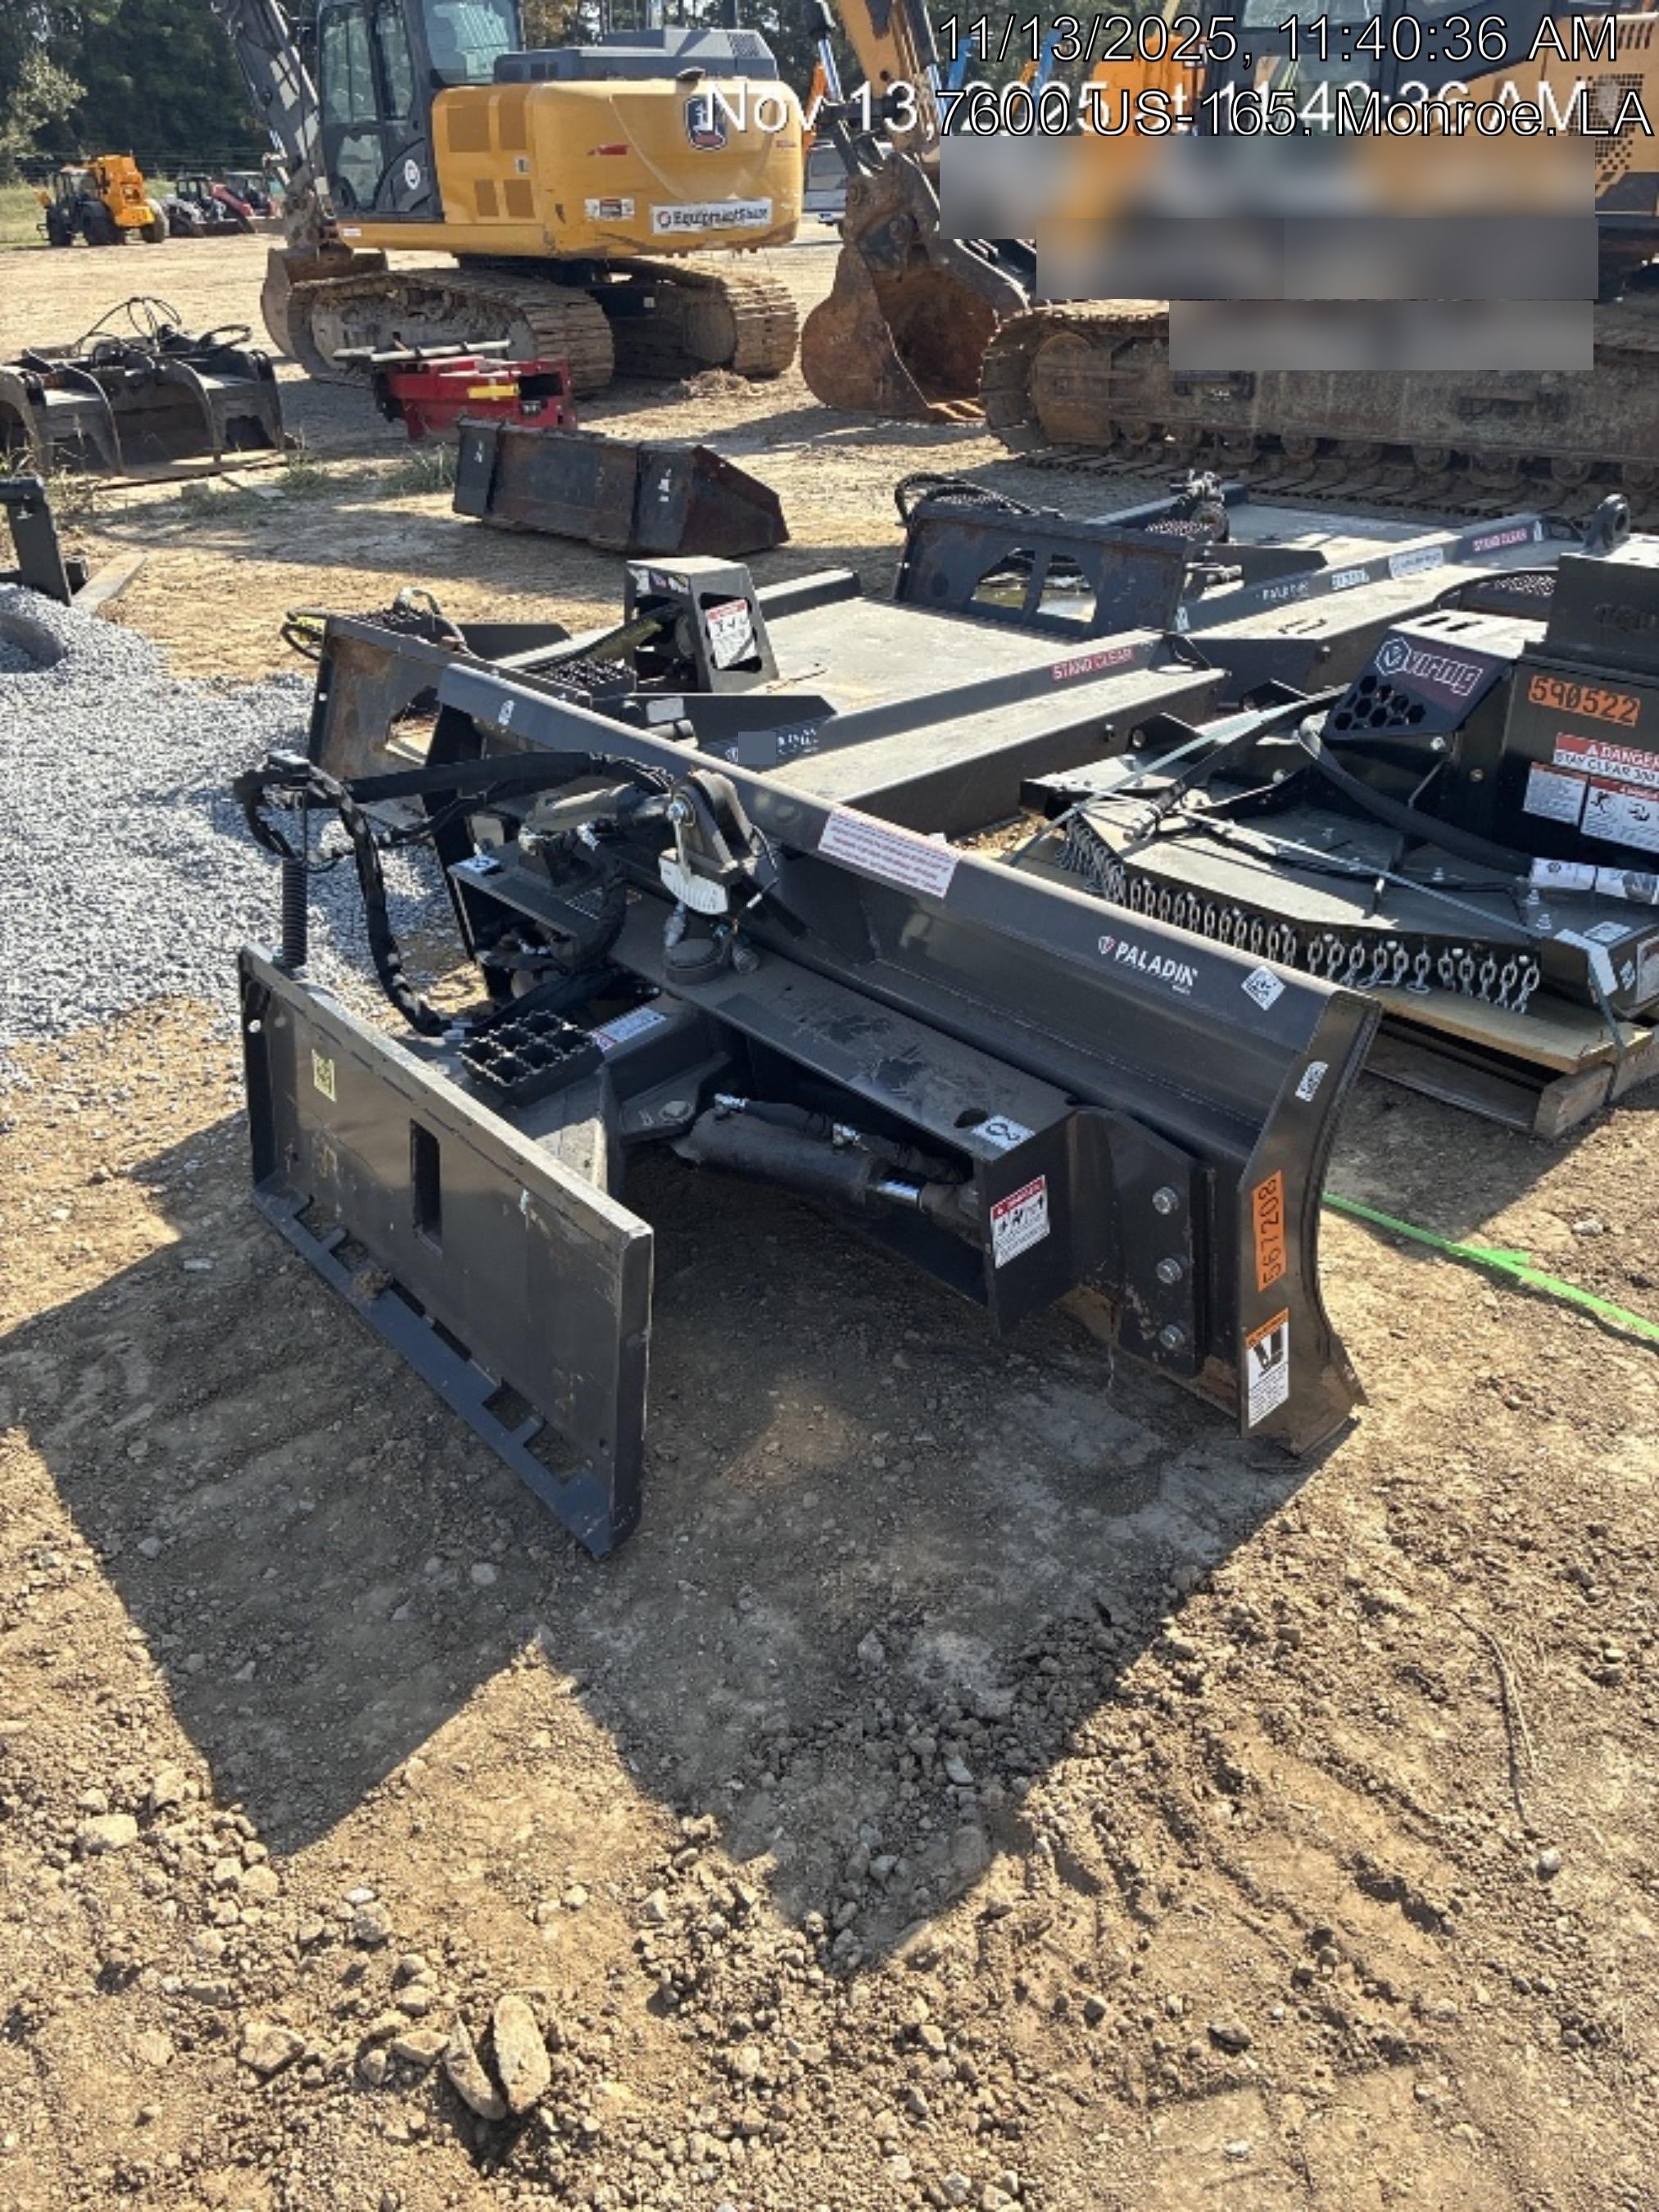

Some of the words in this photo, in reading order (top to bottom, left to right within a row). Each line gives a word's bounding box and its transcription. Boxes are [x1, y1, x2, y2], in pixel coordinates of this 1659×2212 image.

[1530, 675, 1639, 724] 590522
[1113, 941, 1193, 986] PALADIN
[1258, 1178, 1282, 1285] 567208
